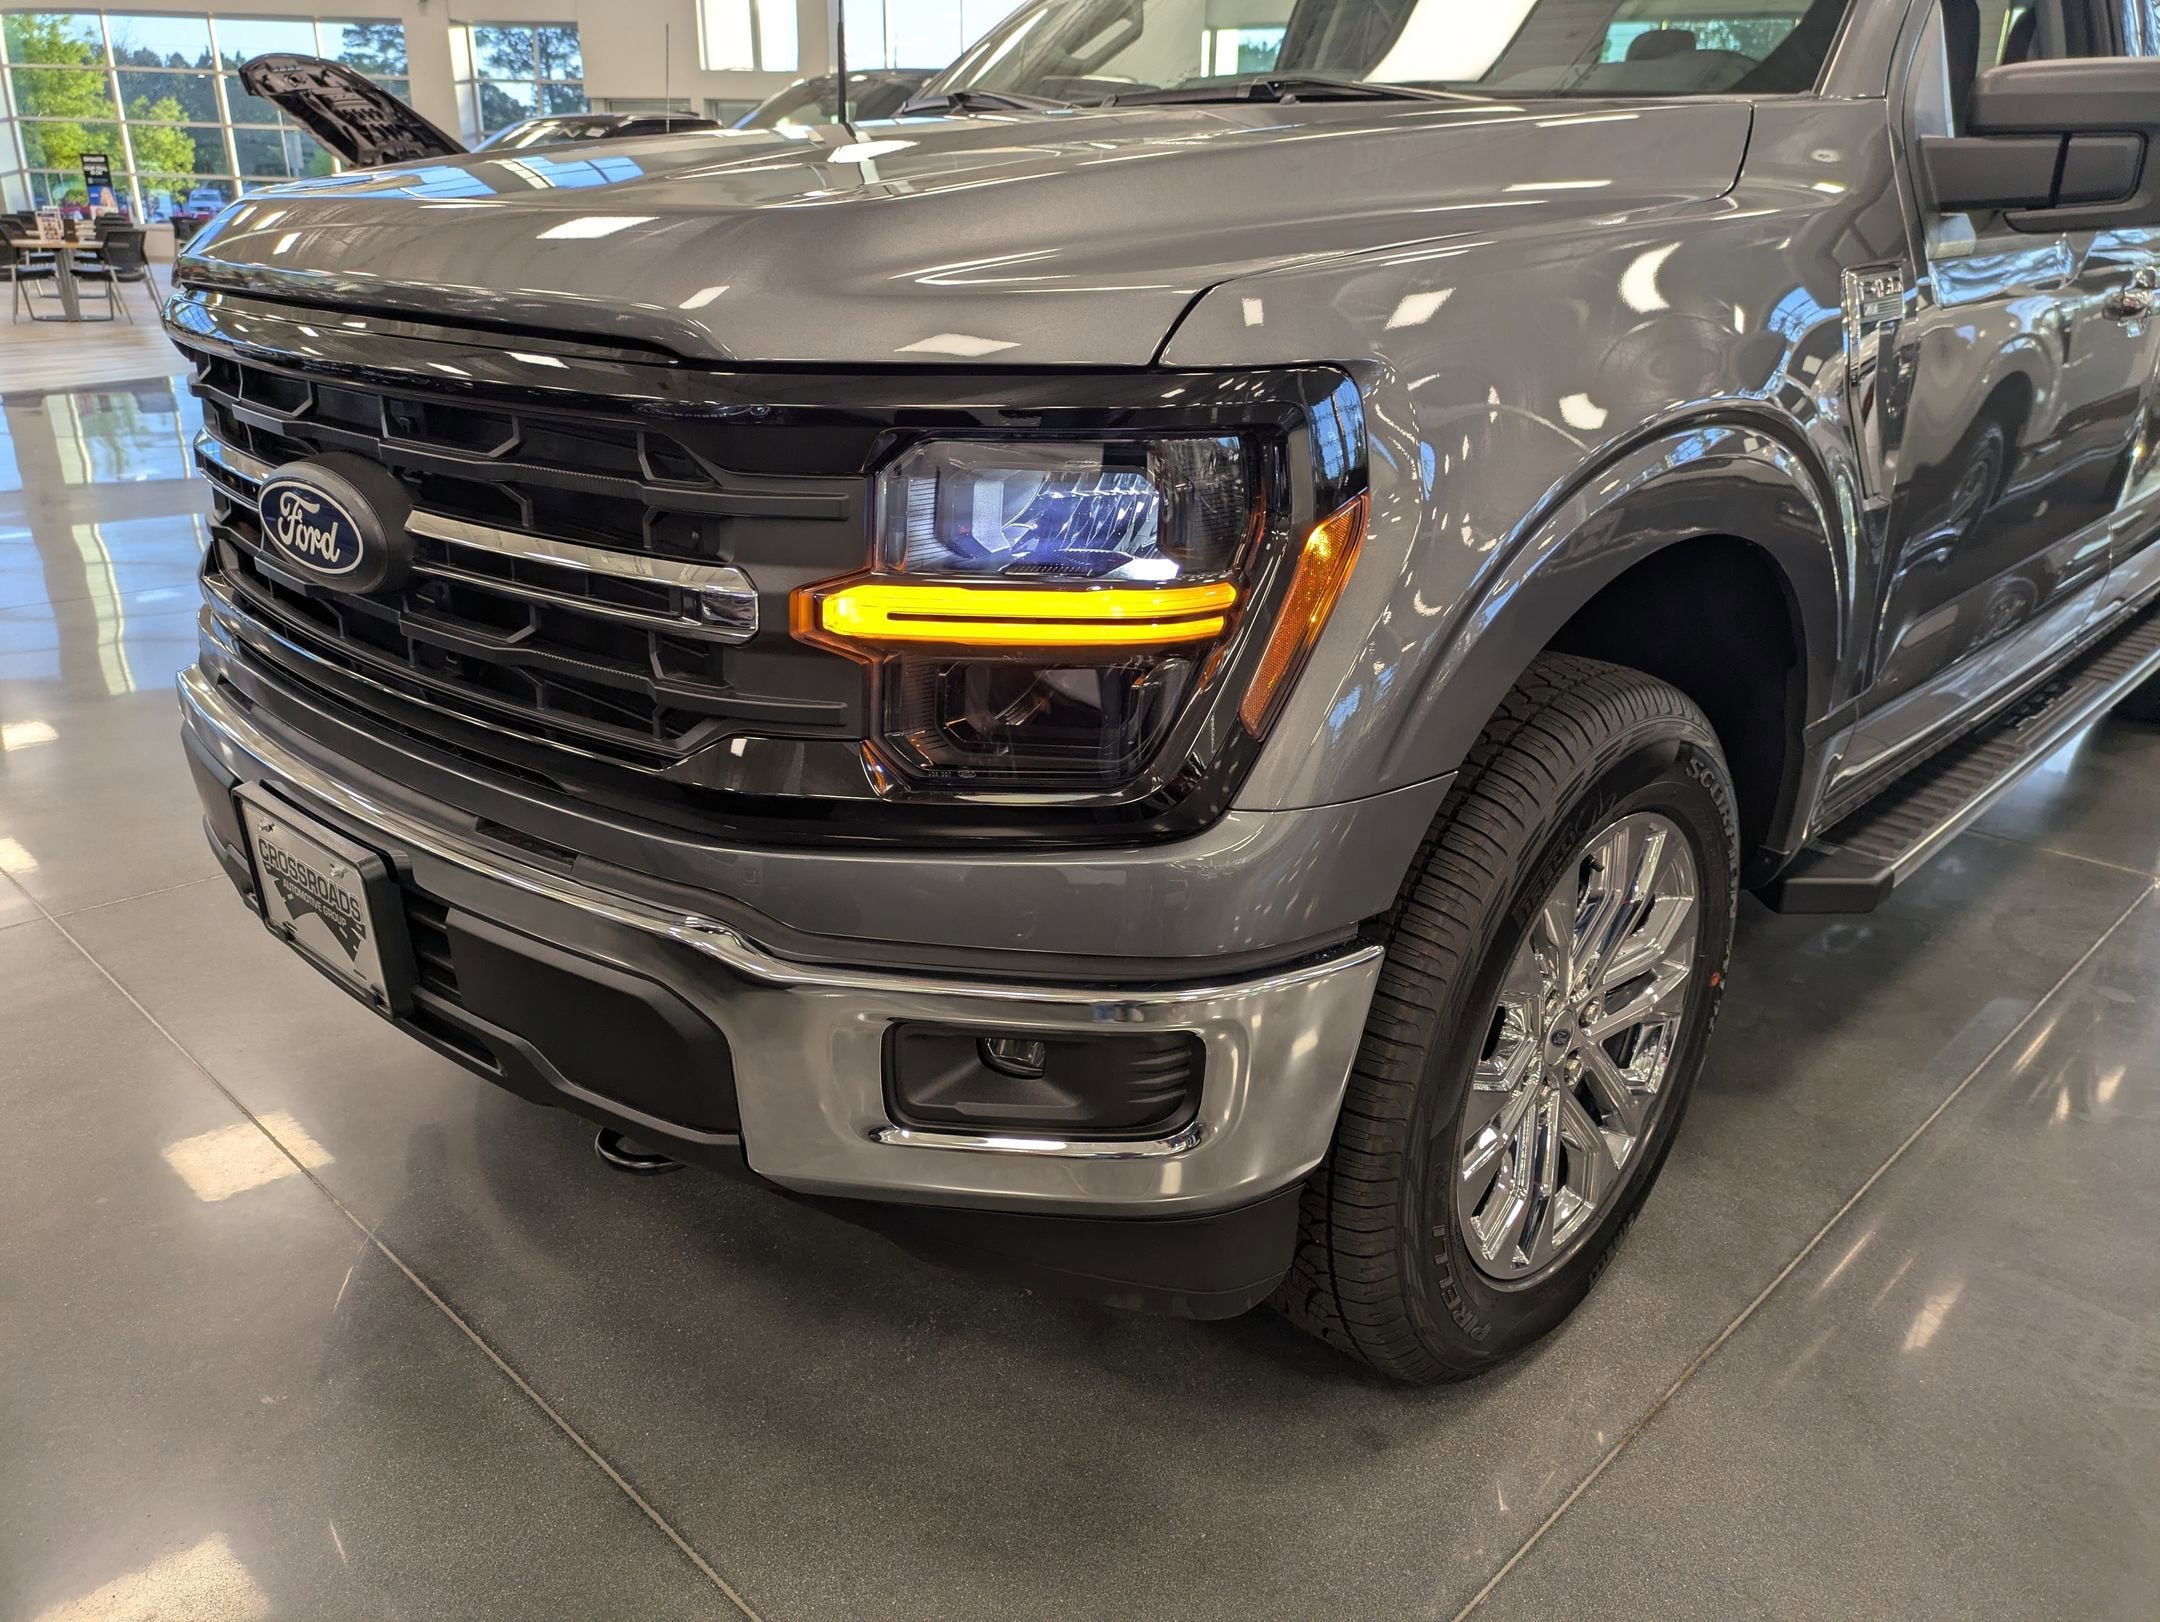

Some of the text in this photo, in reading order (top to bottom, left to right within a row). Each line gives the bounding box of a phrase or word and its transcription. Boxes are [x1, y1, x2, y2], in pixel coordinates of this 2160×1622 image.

[277, 491, 341, 563] Ford
[258, 837, 362, 922] CROSSROADS
[283, 878, 347, 927] AUTOMOTIVE GROUP
[1432, 1224, 1492, 1341] PIRELLI
